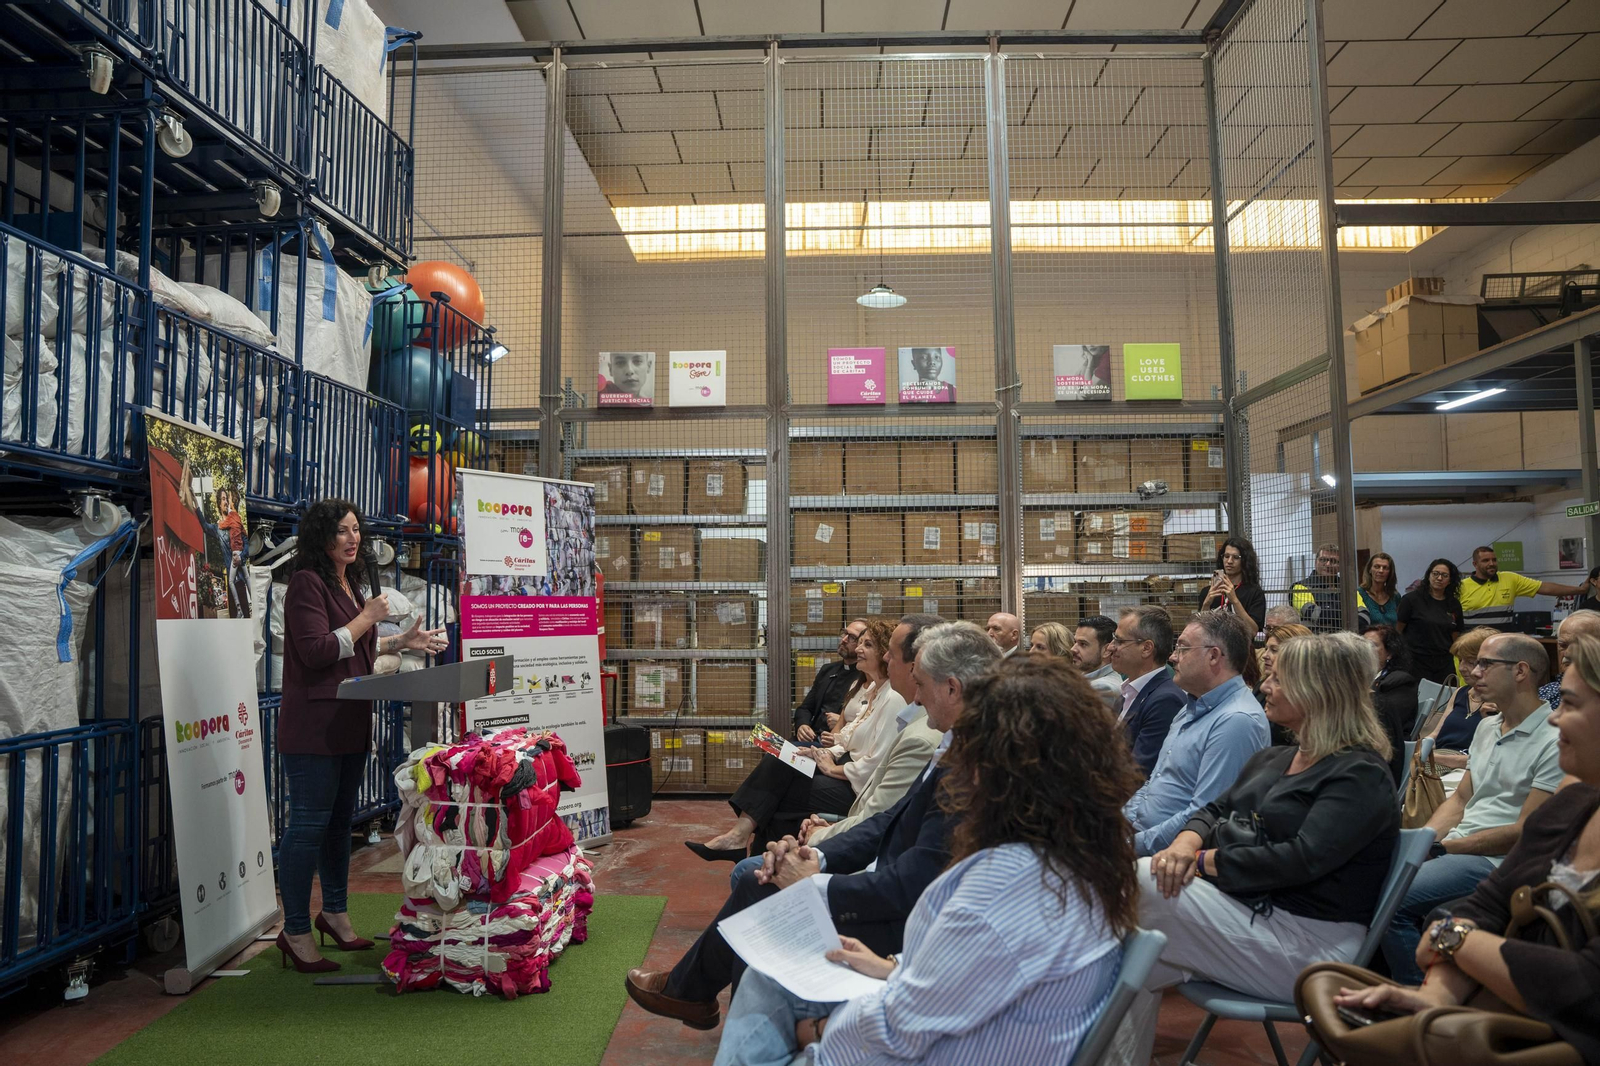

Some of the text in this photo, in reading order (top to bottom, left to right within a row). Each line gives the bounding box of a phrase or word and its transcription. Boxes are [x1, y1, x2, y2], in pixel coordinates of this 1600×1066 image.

[672, 361, 712, 369] koopera
[477, 498, 533, 517] koopera
[1567, 504, 1595, 516] SALIDA
[514, 556, 536, 564] Cáritas
[475, 716, 529, 727] CICLO MEDIOAMBIENTAL
[175, 714, 230, 743] koopera
[235, 728, 254, 740] Cáritas
[556, 801, 582, 811] oopera.org
